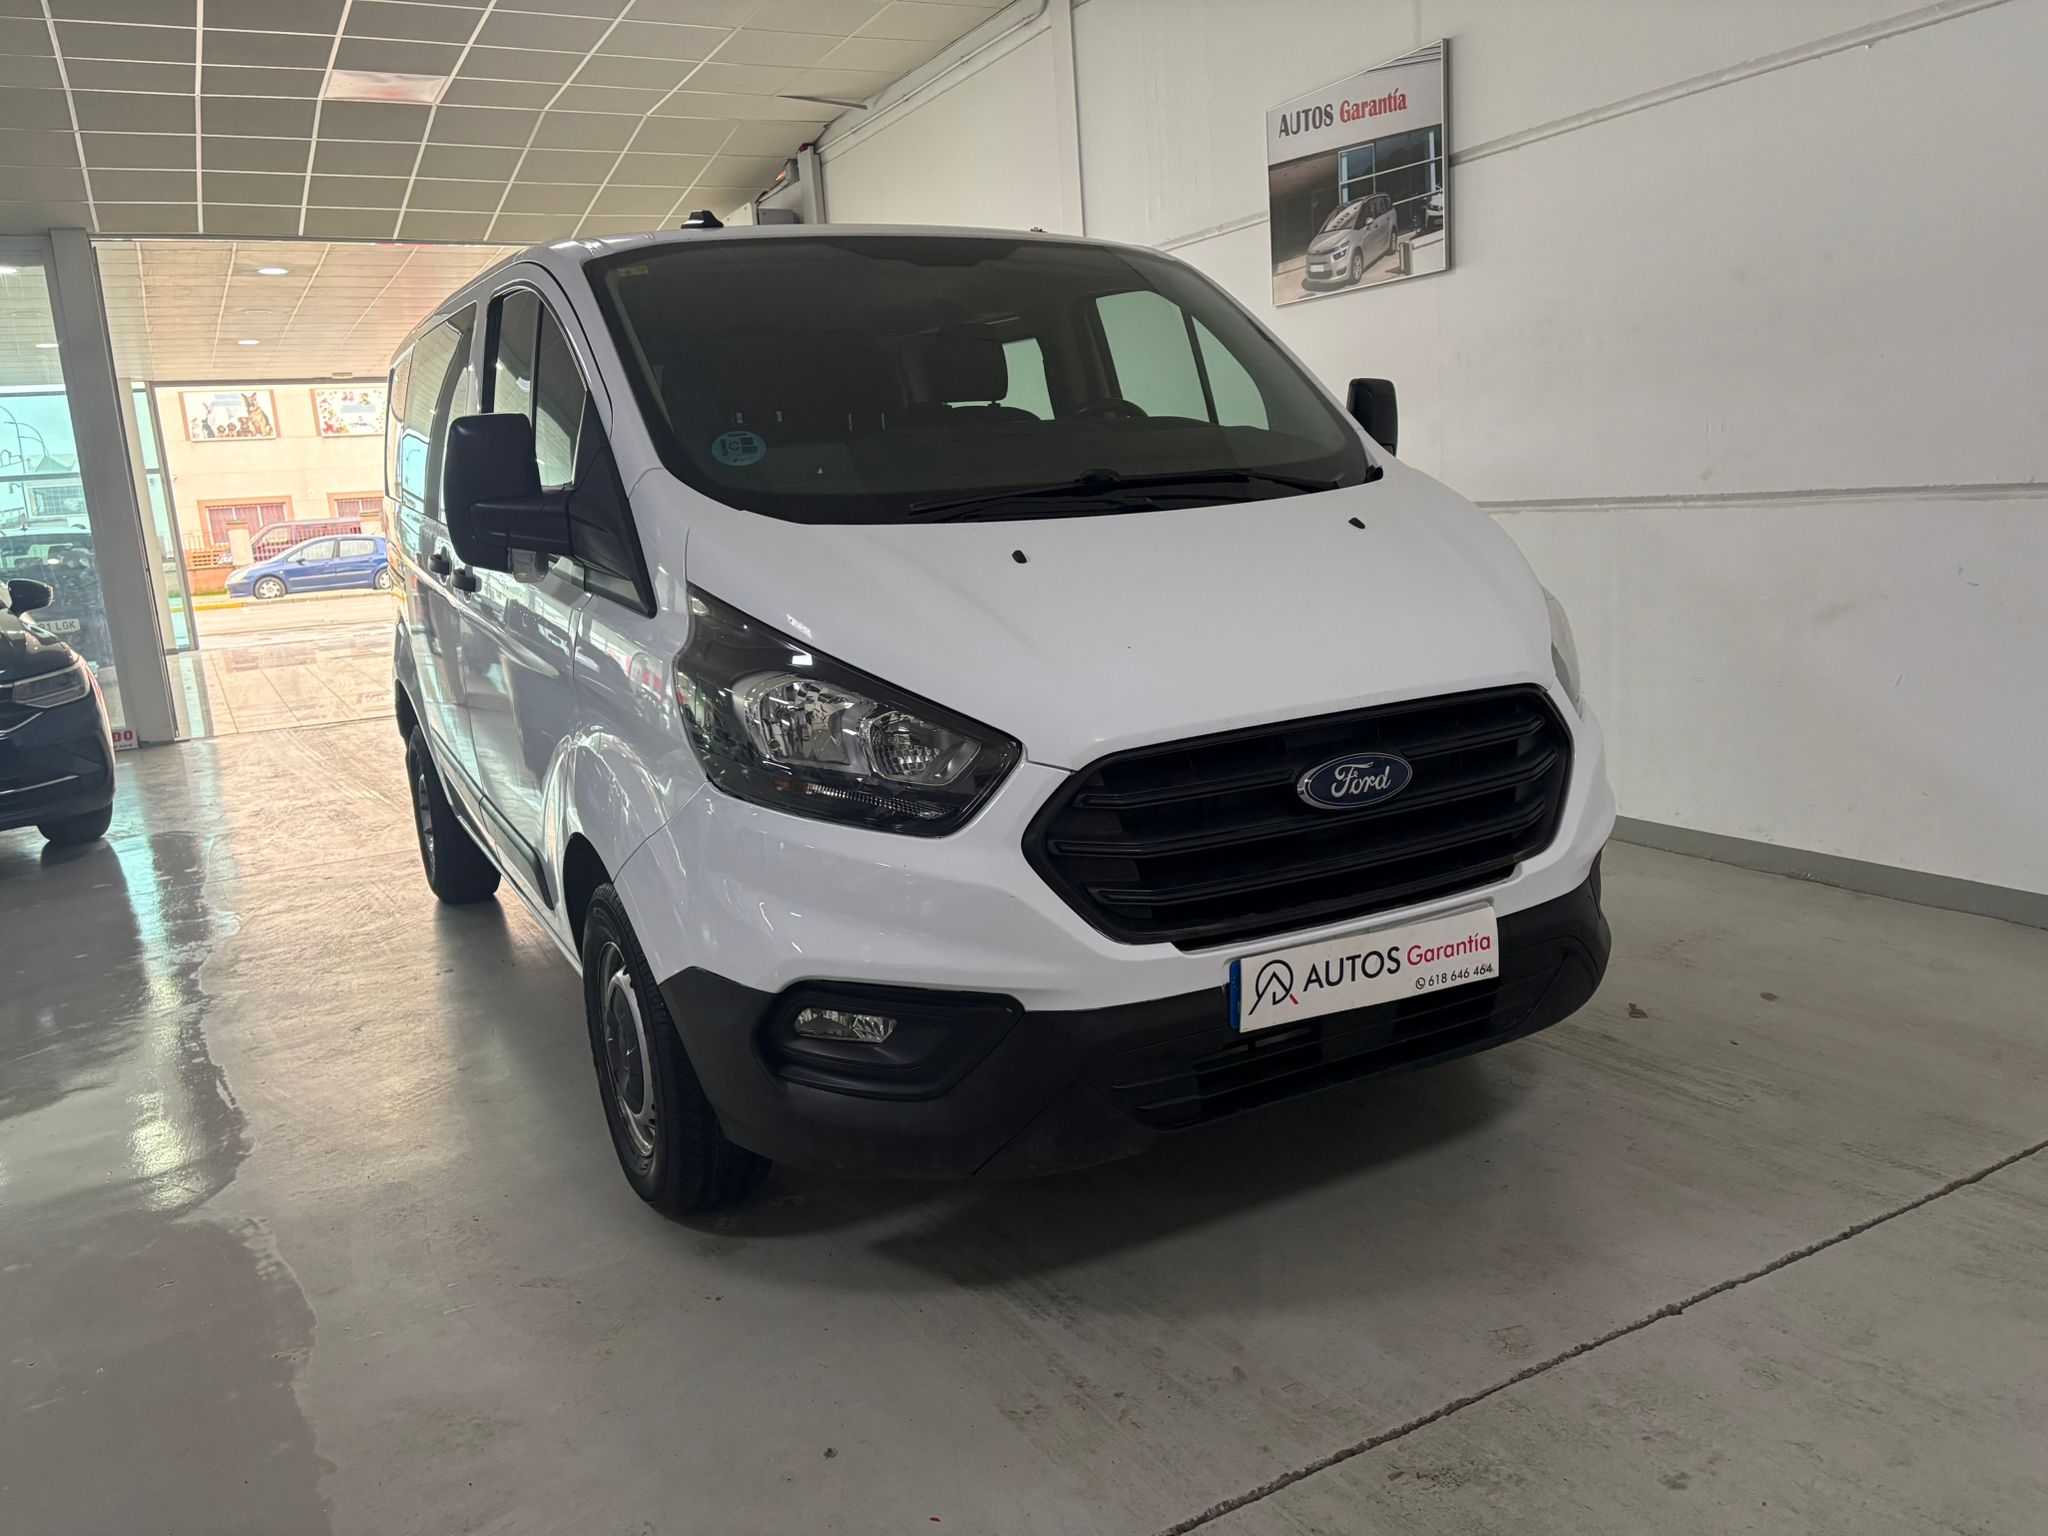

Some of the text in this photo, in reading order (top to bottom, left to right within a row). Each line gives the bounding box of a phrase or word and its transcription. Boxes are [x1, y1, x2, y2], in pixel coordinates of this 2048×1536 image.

[1278, 87, 1408, 138] AUTOS Garantía
[55, 620, 76, 631] LGK
[1331, 761, 1391, 798] Ford
[1303, 933, 1491, 992] AUTOS Garantía
[1428, 962, 1493, 987] 618 646 464
